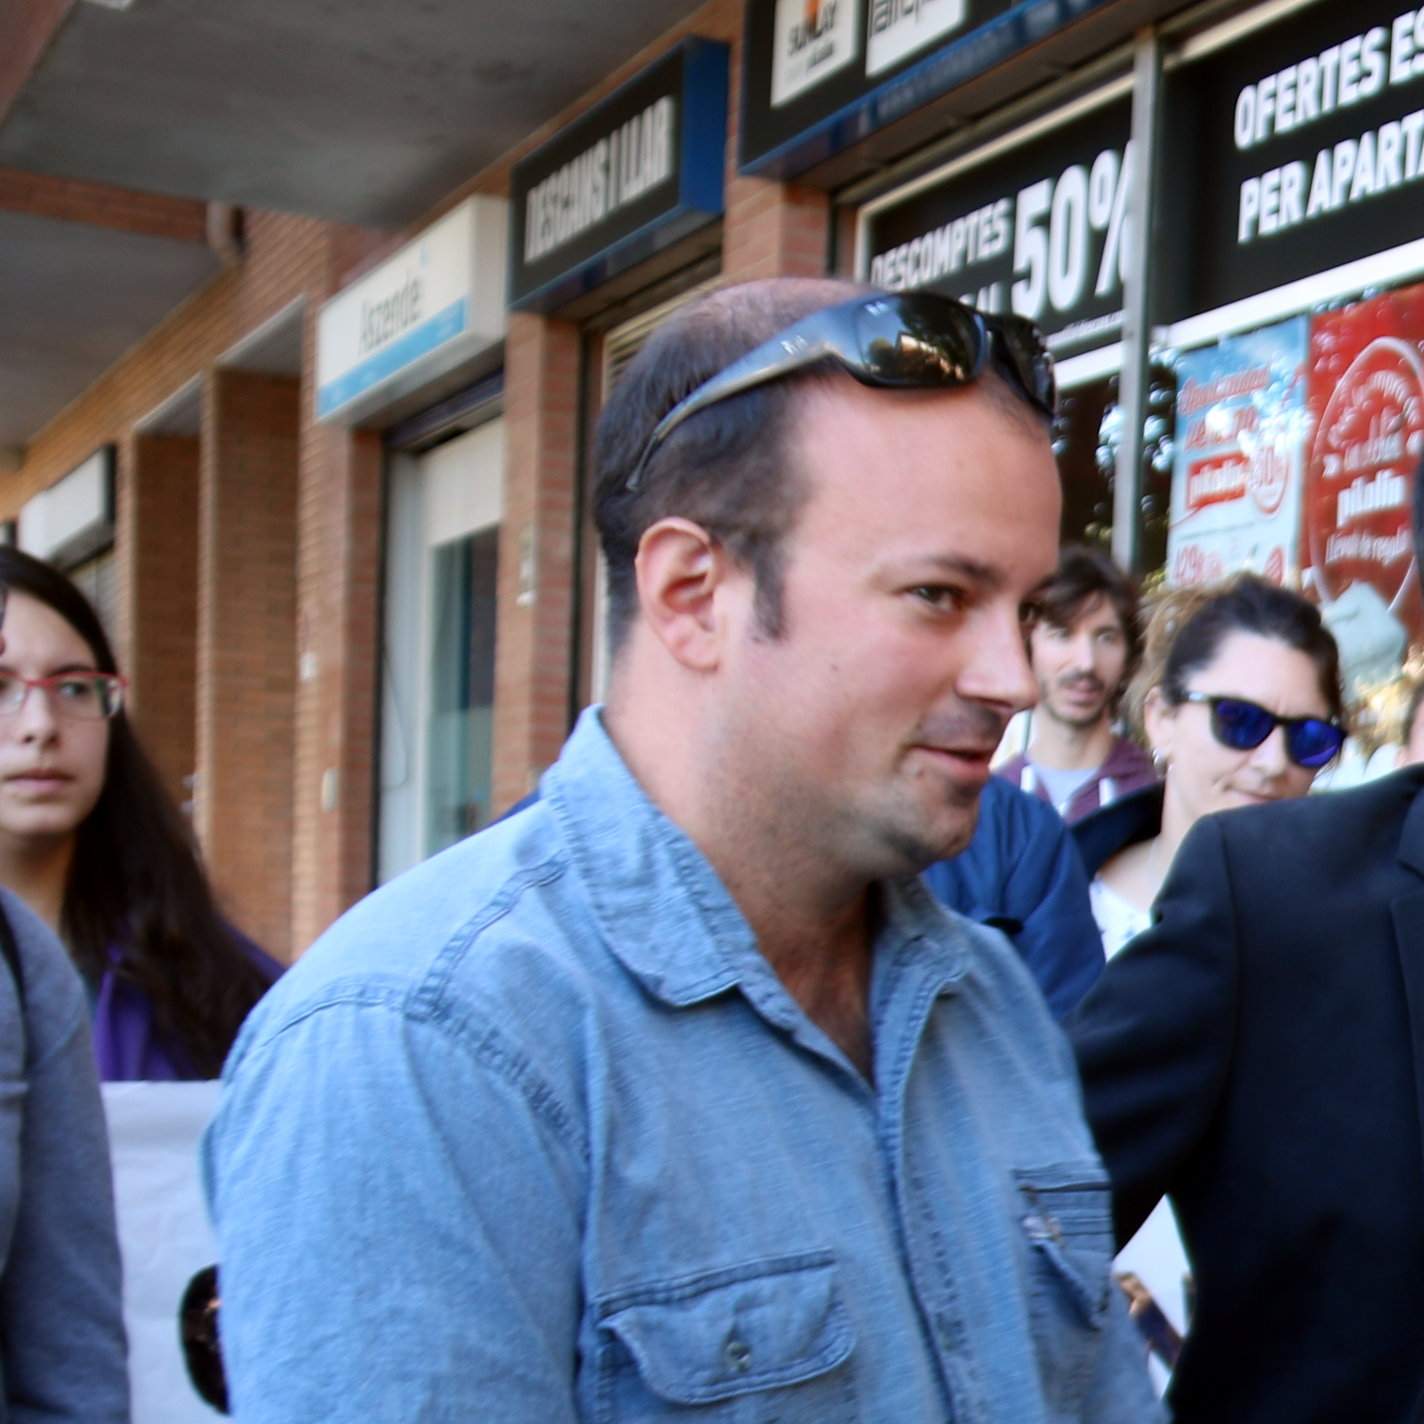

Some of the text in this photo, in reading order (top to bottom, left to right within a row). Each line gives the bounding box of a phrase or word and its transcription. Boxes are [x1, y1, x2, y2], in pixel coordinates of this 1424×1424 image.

[1235, 26, 1389, 149] OFERTES
[870, 197, 1012, 291] DESCOMPTES
[1238, 160, 1308, 244] PER
